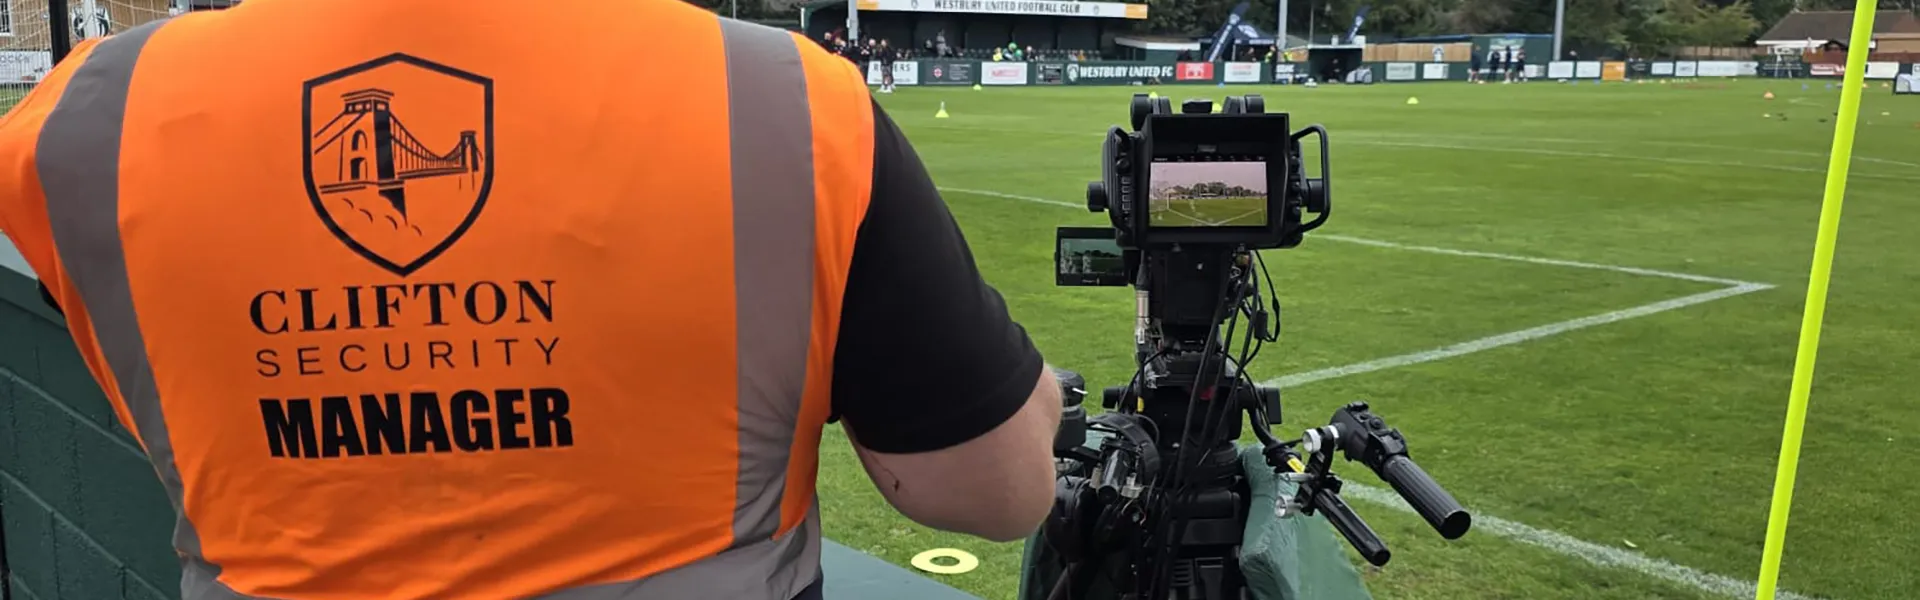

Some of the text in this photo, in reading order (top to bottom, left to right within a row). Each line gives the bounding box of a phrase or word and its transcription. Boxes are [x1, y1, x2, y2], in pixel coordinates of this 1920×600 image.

[985, 1, 1016, 11] UNITED
[1018, 2, 1057, 12] FOOTBALL
[1060, 4, 1080, 13] CLUB
[1080, 66, 1127, 78] WESTBURY
[1128, 66, 1160, 77] UNITED
[1161, 66, 1173, 77] FC
[250, 280, 556, 335] CLIFTON
[256, 337, 560, 377] SECURITY
[259, 387, 574, 459] MANAGER
